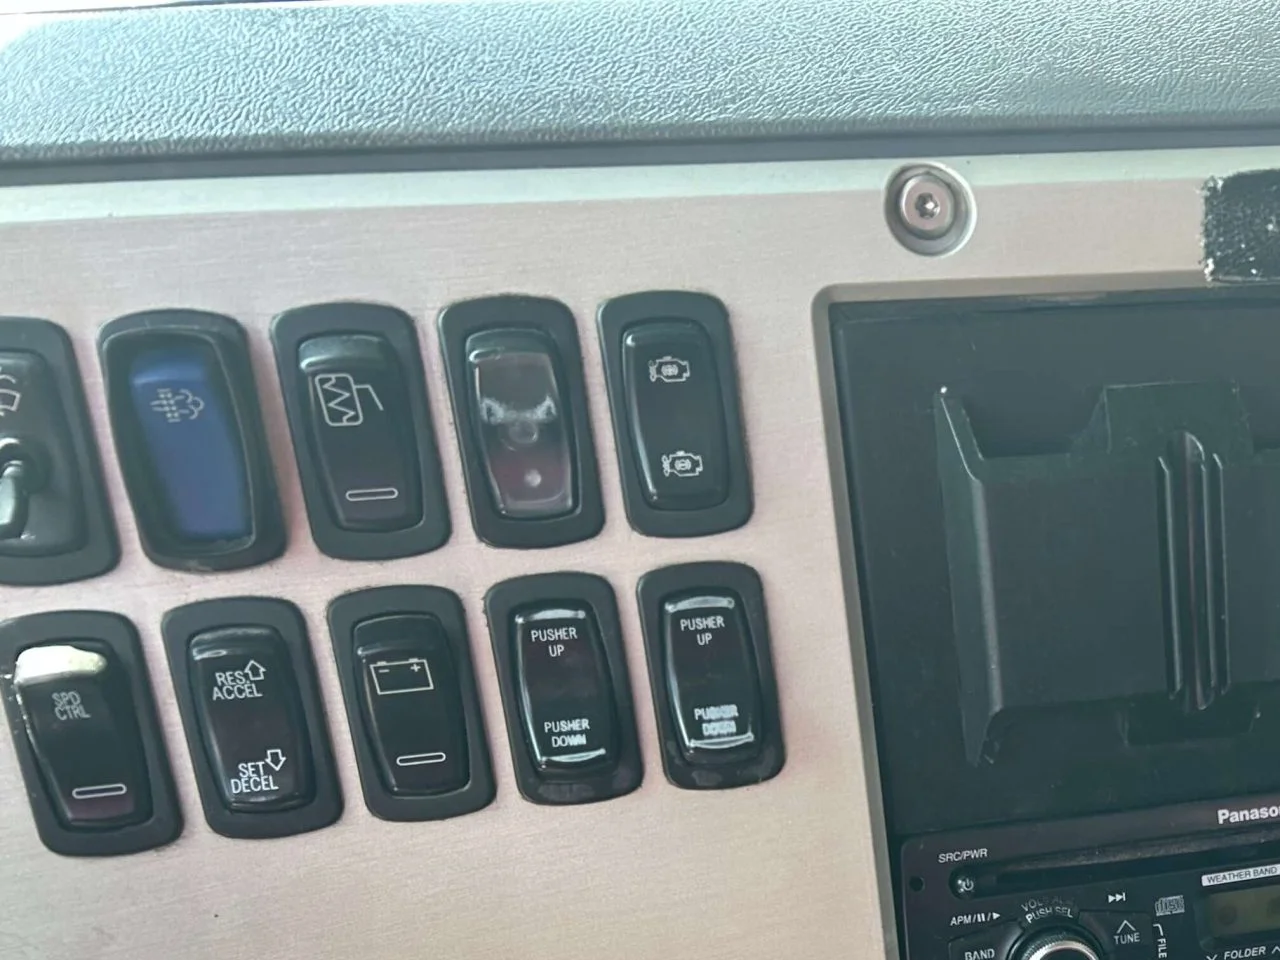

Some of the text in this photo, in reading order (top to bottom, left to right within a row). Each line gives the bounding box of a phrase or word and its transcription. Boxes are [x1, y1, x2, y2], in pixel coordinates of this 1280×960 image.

[680, 616, 725, 631] PUSHER
[531, 627, 578, 642] PUSHER
[696, 633, 713, 645] UP
[548, 645, 565, 657] UP
[51, 691, 81, 706] SPD
[212, 684, 263, 701] ACCEL
[54, 704, 91, 721] CTRL
[544, 719, 590, 733] PUSHER
[551, 734, 587, 748] DOWN
[238, 761, 265, 778] SET
[230, 776, 279, 794] DECEL
[938, 848, 988, 864] SRC/PWR
[1207, 866, 1278, 884] WEATHER BAND
[1114, 932, 1141, 945] TUNE
[1157, 938, 1167, 959] FILE
[1223, 946, 1266, 960] FOLDER
